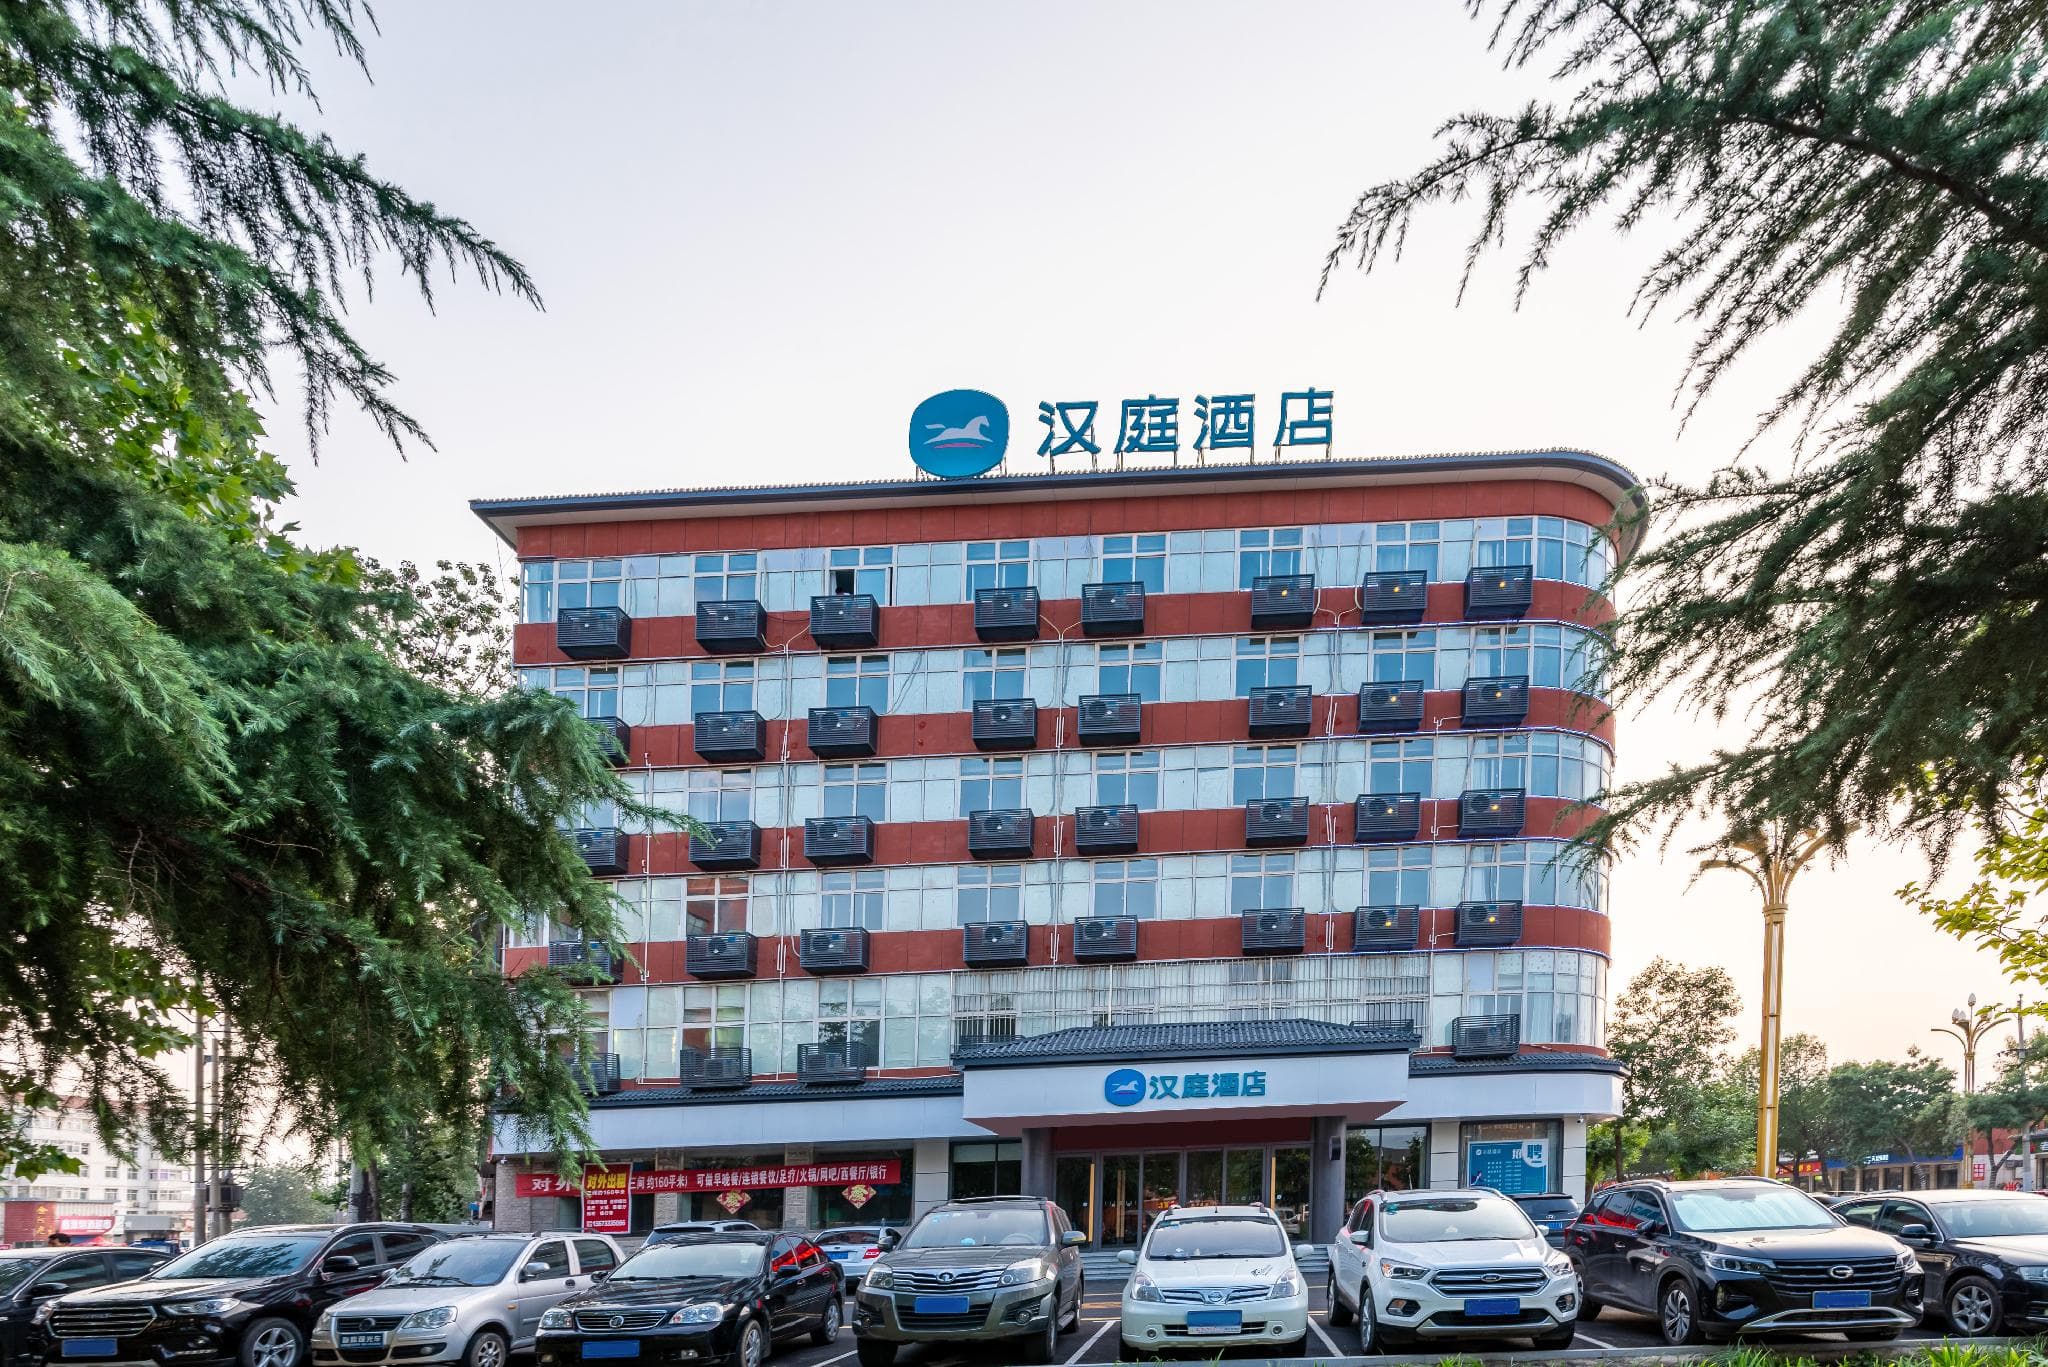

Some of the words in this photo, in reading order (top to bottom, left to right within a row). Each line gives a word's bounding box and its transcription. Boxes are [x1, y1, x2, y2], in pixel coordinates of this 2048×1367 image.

[1037, 387, 1334, 456] 汉庭酒店
[1149, 1071, 1266, 1099] 汉庭酒店
